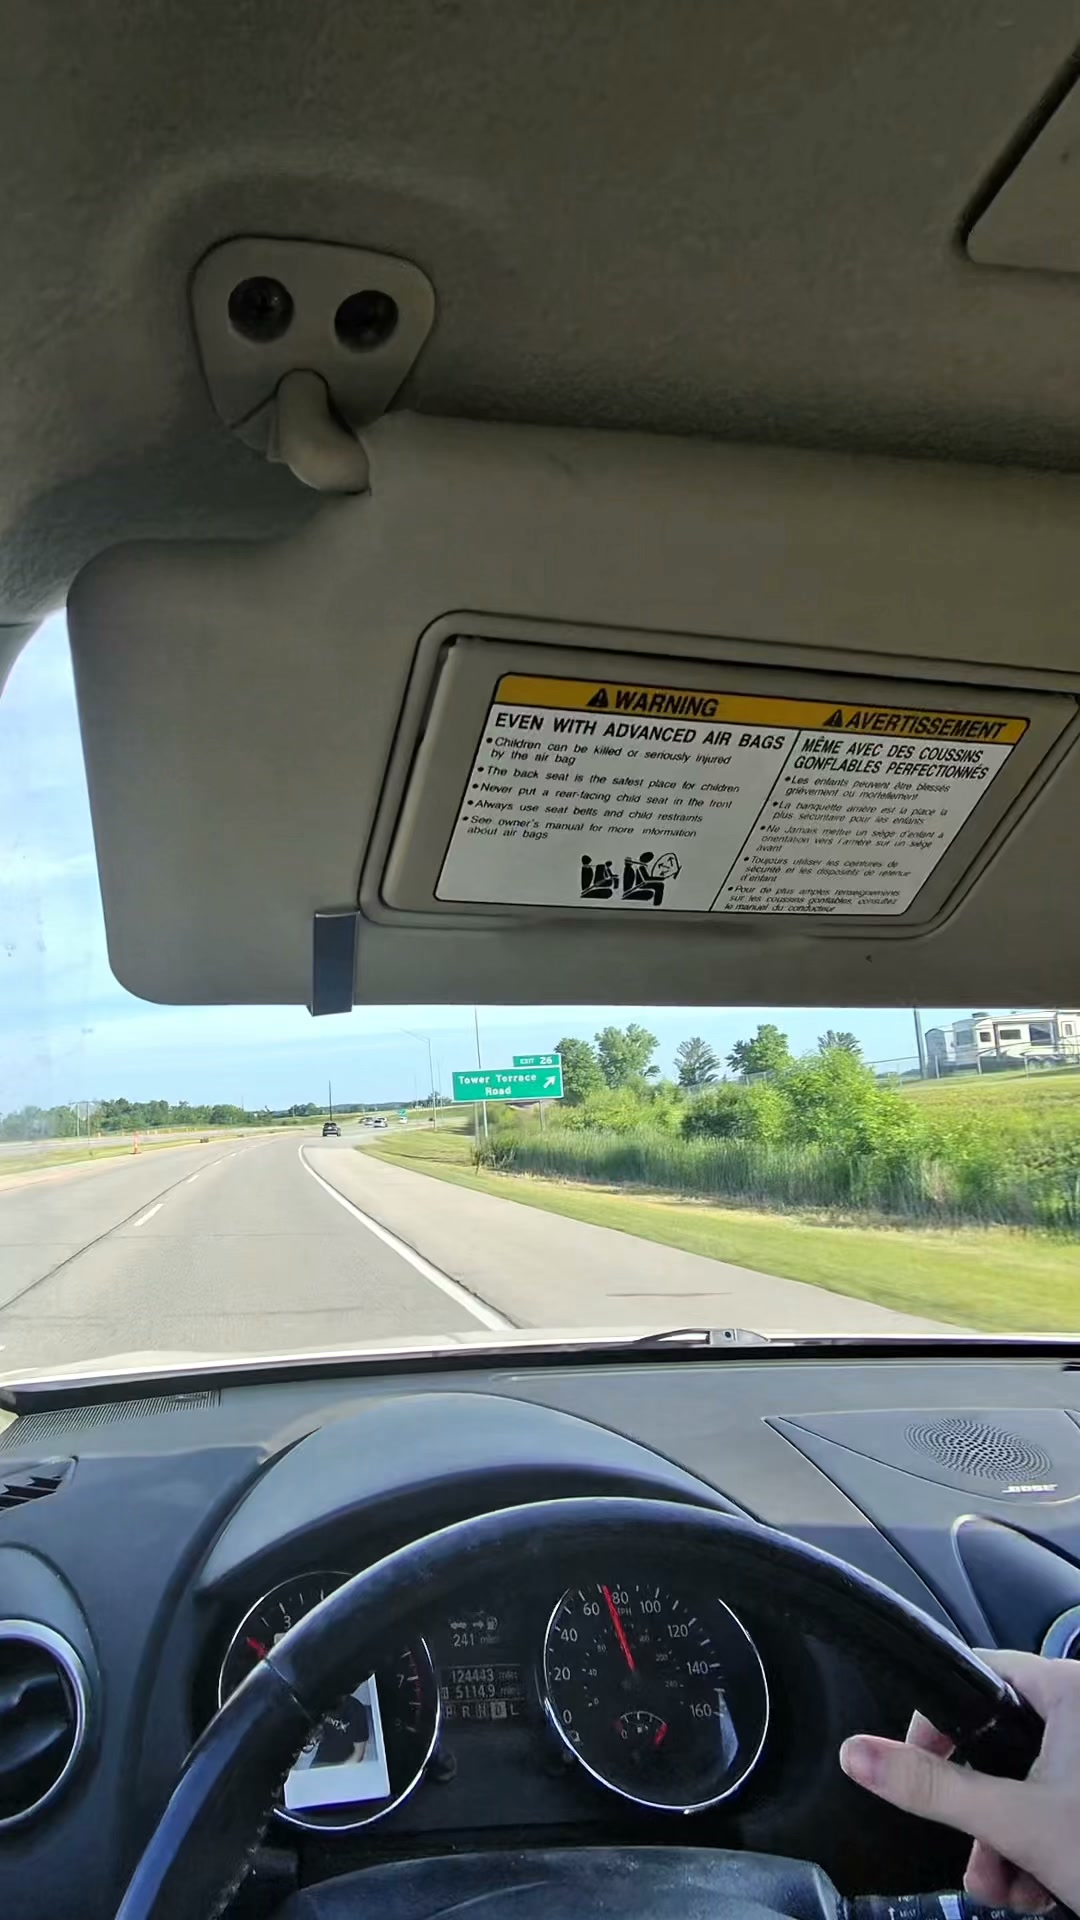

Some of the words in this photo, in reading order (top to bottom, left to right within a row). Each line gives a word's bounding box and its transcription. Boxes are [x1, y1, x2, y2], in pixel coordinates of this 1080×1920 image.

[615, 690, 719, 717] WARNING
[495, 712, 544, 731] EVEN
[553, 717, 597, 735] WITH
[603, 722, 697, 743] ADVANCED
[702, 730, 732, 746] AIR
[738, 734, 785, 750] BAGS
[845, 711, 1008, 740] AVERTISSEMENT
[490, 748, 504, 760] by
[511, 750, 529, 761] the
[534, 751, 550, 761] air
[554, 754, 576, 766] bag
[494, 736, 541, 750] Children
[547, 743, 568, 752] can
[574, 743, 588, 754] be
[594, 745, 623, 757] killed
[627, 749, 639, 757] or
[644, 748, 691, 763] seriously
[696, 753, 732, 765] injured
[801, 736, 844, 755] MÊME
[846, 741, 883, 757] AVEC
[887, 744, 915, 759] DES
[919, 747, 984, 764] COUSSINS
[794, 755, 883, 774] GONFLABLES
[885, 761, 990, 780] PERFECTIONNÉS
[487, 765, 508, 776] The
[513, 768, 539, 779] back
[545, 772, 569, 781] seat
[574, 773, 584, 782] is
[589, 774, 607, 784] the
[612, 776, 644, 787] safest
[648, 779, 677, 790] place
[681, 780, 697, 790] for
[700, 783, 740, 793] children
[791, 775, 809, 785] Les
[814, 777, 849, 787] enfants
[852, 779, 891, 790] peuvent
[480, 782, 513, 794] Never
[518, 786, 536, 796] put
[542, 789, 549, 797] a
[555, 790, 611, 803] rear-facing
[616, 793, 641, 803] child
[646, 796, 669, 805] seat
[673, 796, 683, 805] in
[688, 797, 704, 807] the
[709, 799, 733, 809] front
[842, 789, 856, 798] ou
[475, 799, 514, 812] Always
[519, 804, 539, 812] use
[544, 805, 568, 814] seat
[573, 806, 598, 817] belts
[603, 809, 624, 818] and
[628, 810, 653, 820] child
[658, 812, 703, 823] restraints
[779, 800, 792, 810] La
[467, 825, 498, 836] about
[503, 828, 517, 837] air
[522, 830, 549, 841] bags
[469, 815, 492, 825] See
[498, 818, 539, 829] owner's
[545, 821, 584, 832] manual
[589, 822, 603, 833] for
[608, 825, 635, 835] more
[642, 826, 697, 838] information
[766, 824, 780, 833] Ne
[539, 1056, 553, 1066] 26
[459, 1075, 490, 1085] Tower
[496, 1074, 537, 1083] Terrace
[485, 1086, 511, 1096] Road
[612, 1591, 629, 1605] 80
[583, 1604, 600, 1617] 60
[640, 1600, 661, 1613] 100
[284, 1615, 292, 1629] 3
[560, 1628, 579, 1643] 40
[668, 1624, 688, 1638] 120
[453, 1633, 475, 1648] 241
[452, 1668, 495, 1683] 124443
[554, 1667, 571, 1681] 20
[687, 1660, 709, 1676] 140
[462, 1705, 470, 1718] R
[563, 1709, 573, 1724] 0
[690, 1703, 712, 1718] 160
